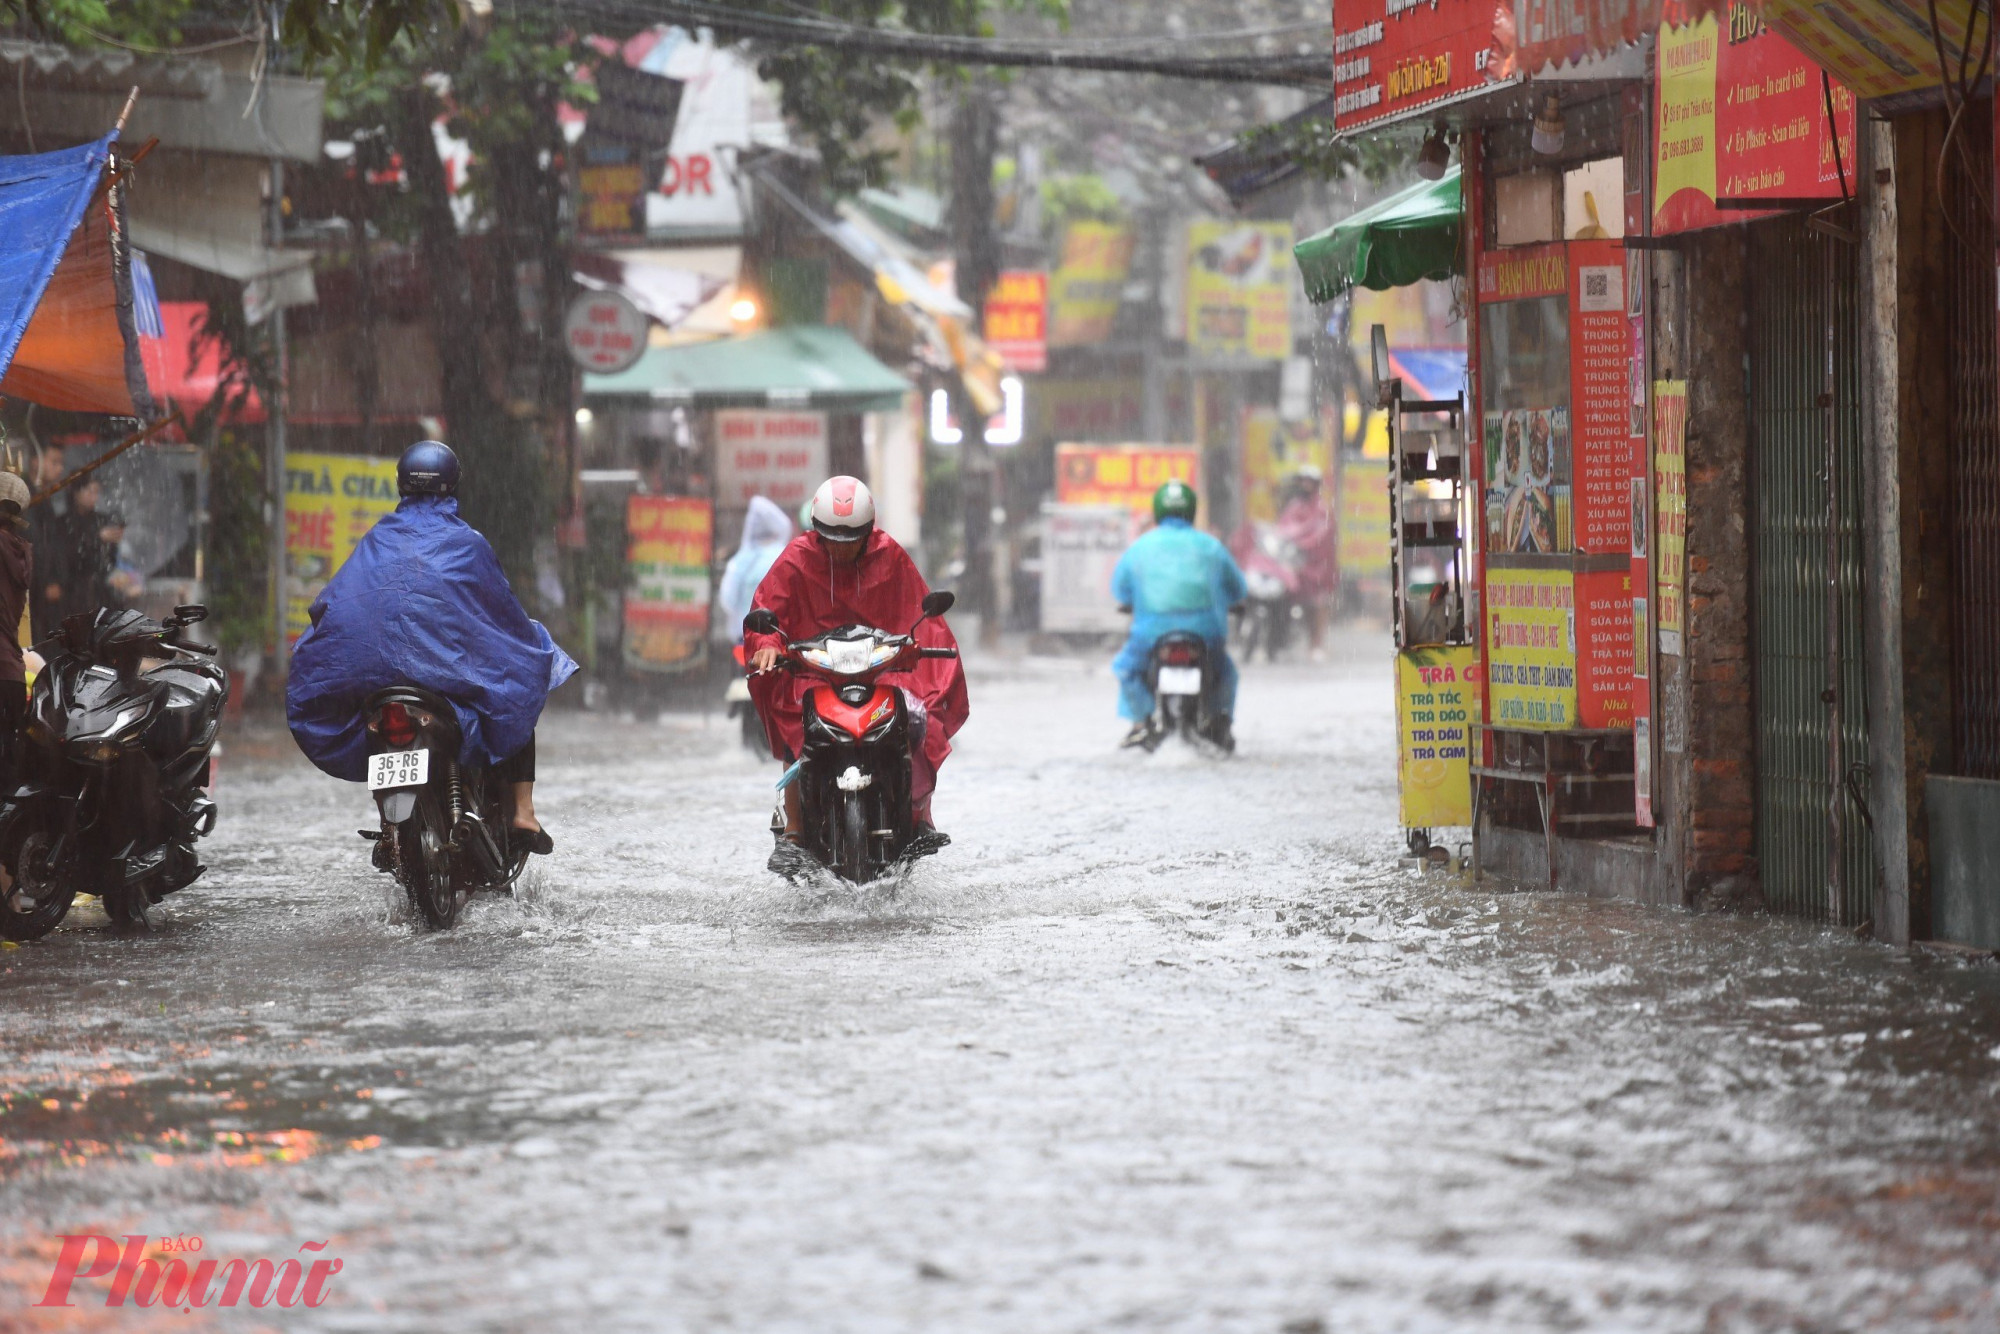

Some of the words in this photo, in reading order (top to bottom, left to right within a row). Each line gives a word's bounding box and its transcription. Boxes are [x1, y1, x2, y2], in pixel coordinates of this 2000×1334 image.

[1737, 83, 1743, 104] In
[1766, 76, 1774, 96] In
[1775, 70, 1790, 93] card
[1792, 66, 1805, 89] visit
[1746, 128, 1767, 150] Plastic
[1772, 124, 1787, 143] Scan
[1788, 119, 1797, 139] tài
[1798, 116, 1810, 141] liệu
[1735, 175, 1742, 195] In
[1760, 168, 1772, 190] báo
[1773, 166, 1785, 188] cáo
[1585, 440, 1611, 450] PATE
[1586, 454, 1612, 464] PATE
[1586, 468, 1612, 478] PATE
[1587, 482, 1612, 492] PATE
[1603, 699, 1627, 711] Nhà
[1439, 747, 1466, 758] CAM
[378, 753, 419, 770] 36-R6
[377, 768, 418, 785] 9796
